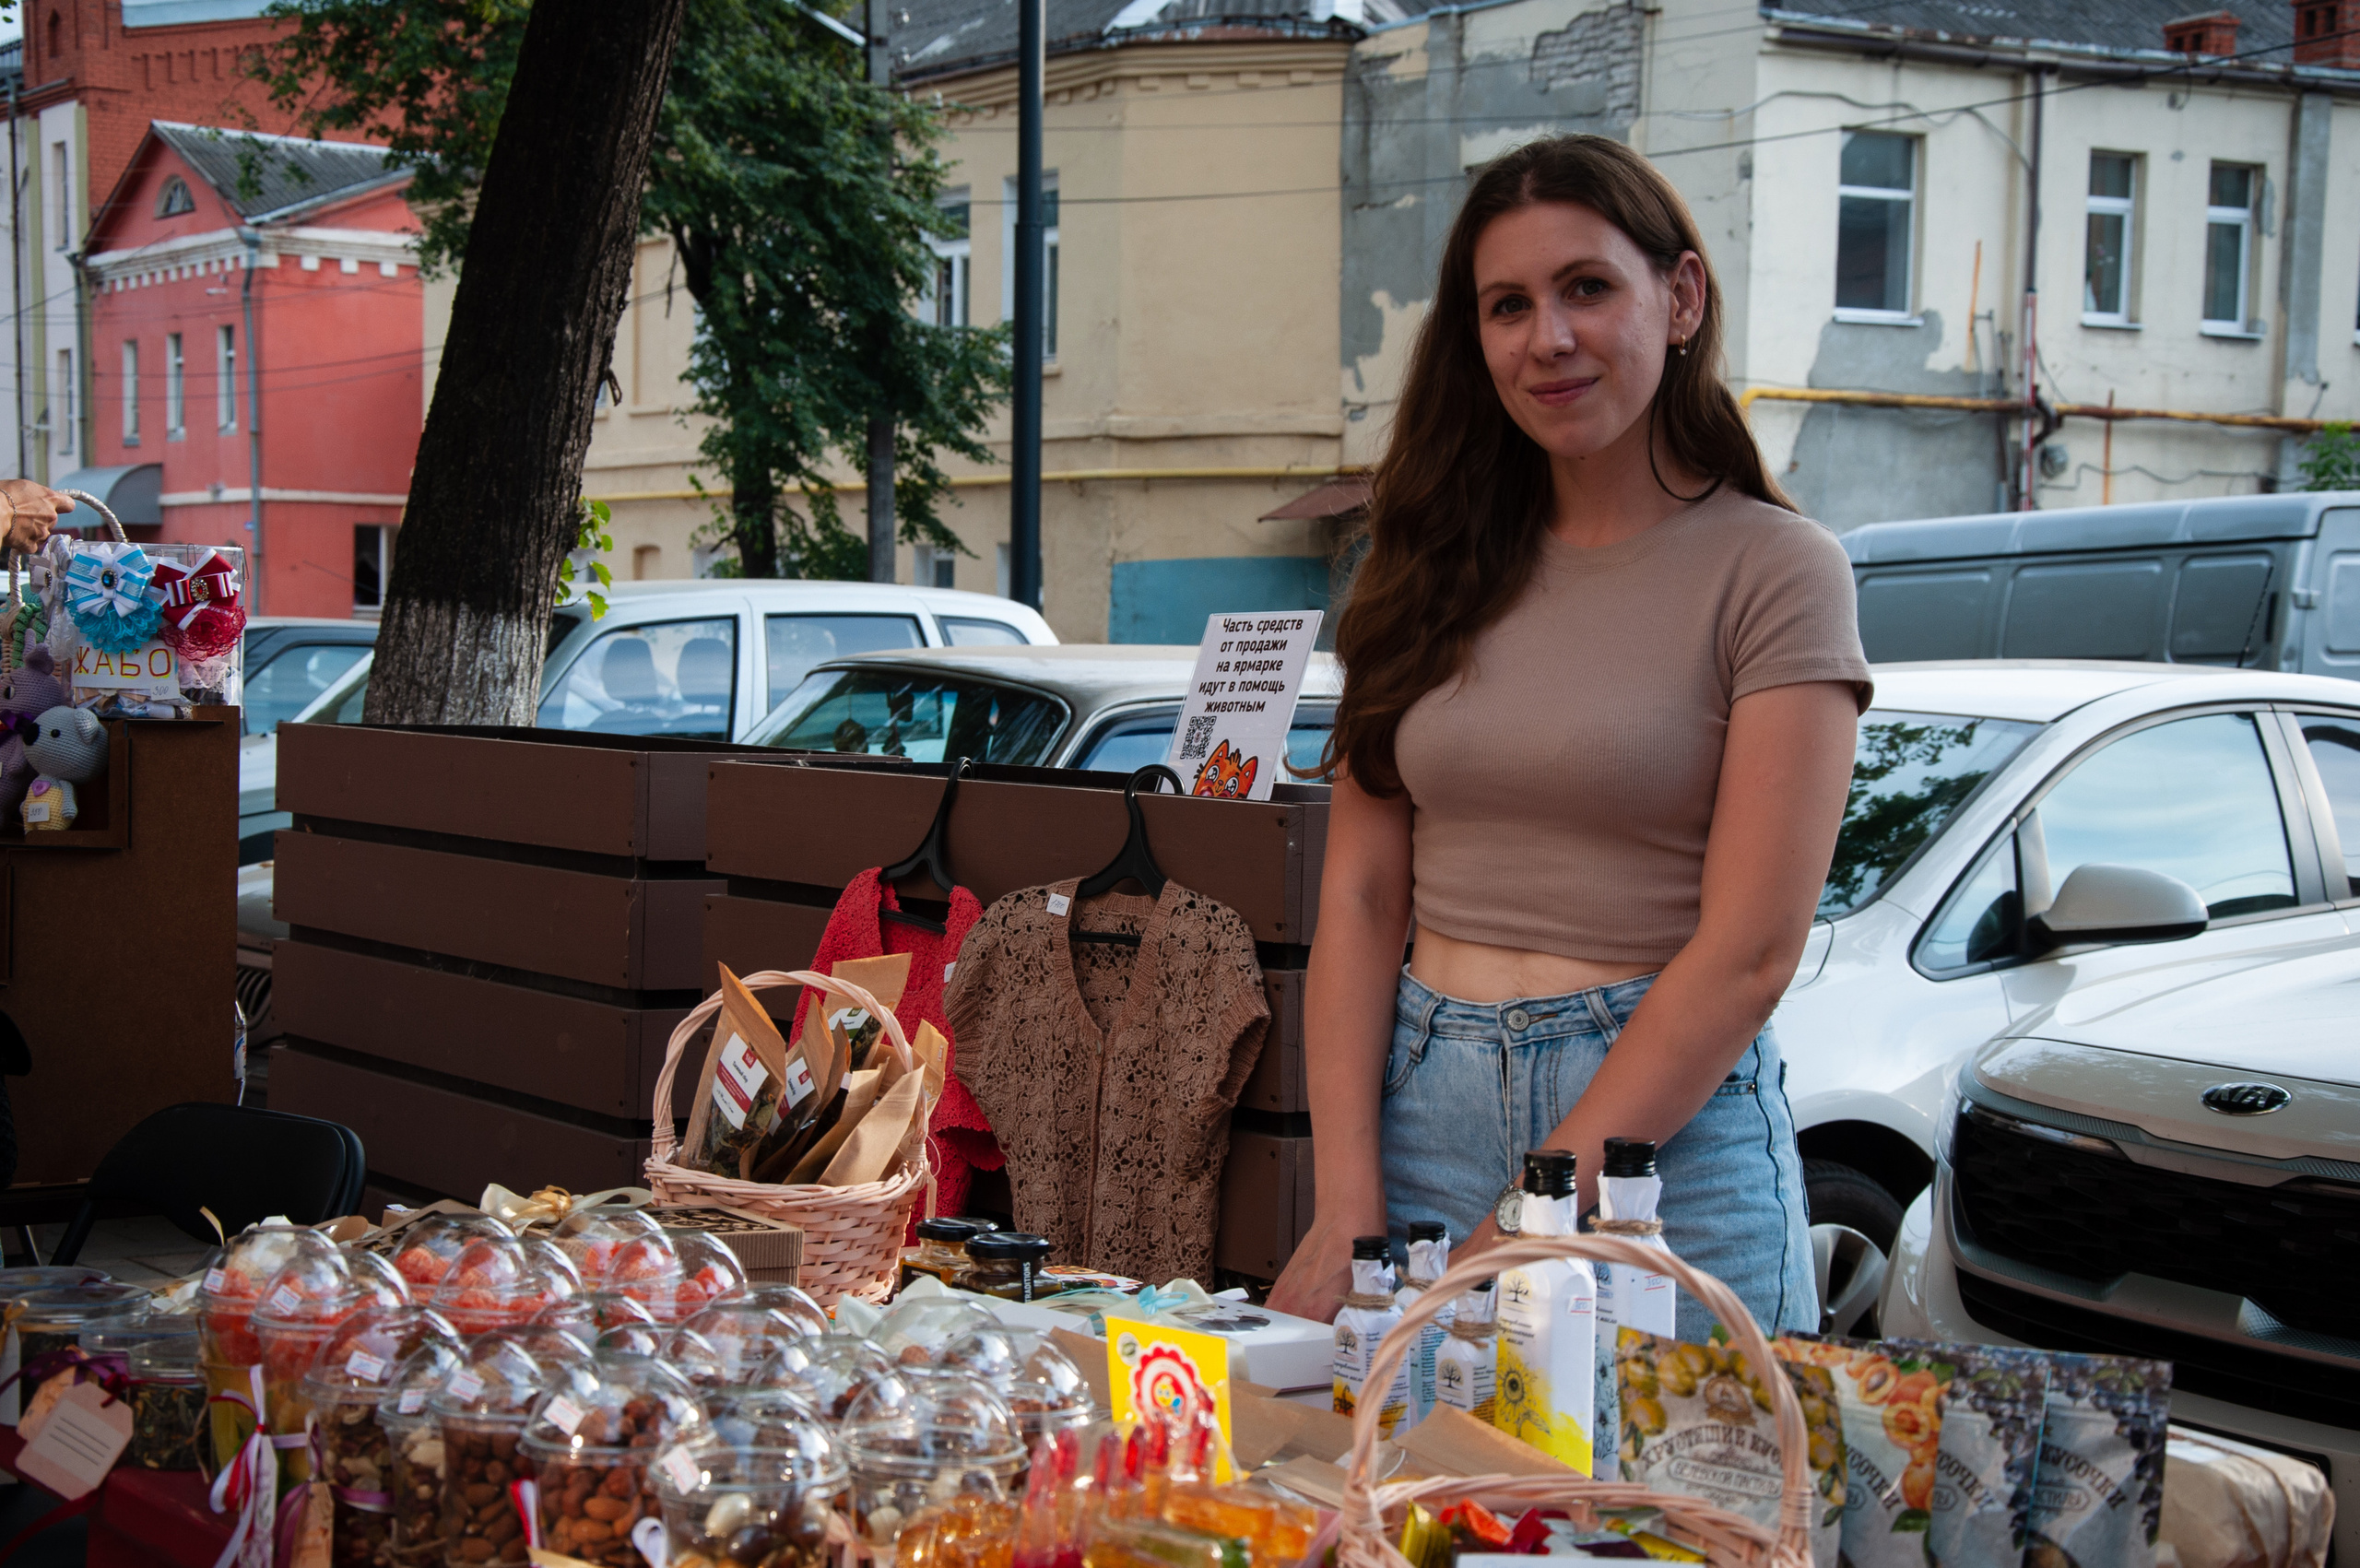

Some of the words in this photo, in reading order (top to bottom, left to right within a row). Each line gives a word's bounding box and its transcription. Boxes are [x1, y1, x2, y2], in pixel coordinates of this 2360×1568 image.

[1222, 618, 1253, 633] Часть
[1257, 618, 1303, 635] средств
[1220, 642, 1233, 653] от
[1235, 639, 1288, 655] продажи
[74, 646, 171, 678] ЖАБО
[1216, 662, 1229, 673] на
[1233, 659, 1283, 676] ярмарке
[152, 685, 170, 696] 300
[1198, 681, 1226, 696] идут
[1228, 682, 1234, 691] в
[1238, 679, 1285, 694] помощь
[1204, 700, 1266, 713] животным
[1022, 1261, 1032, 1303] TRADITIONS
